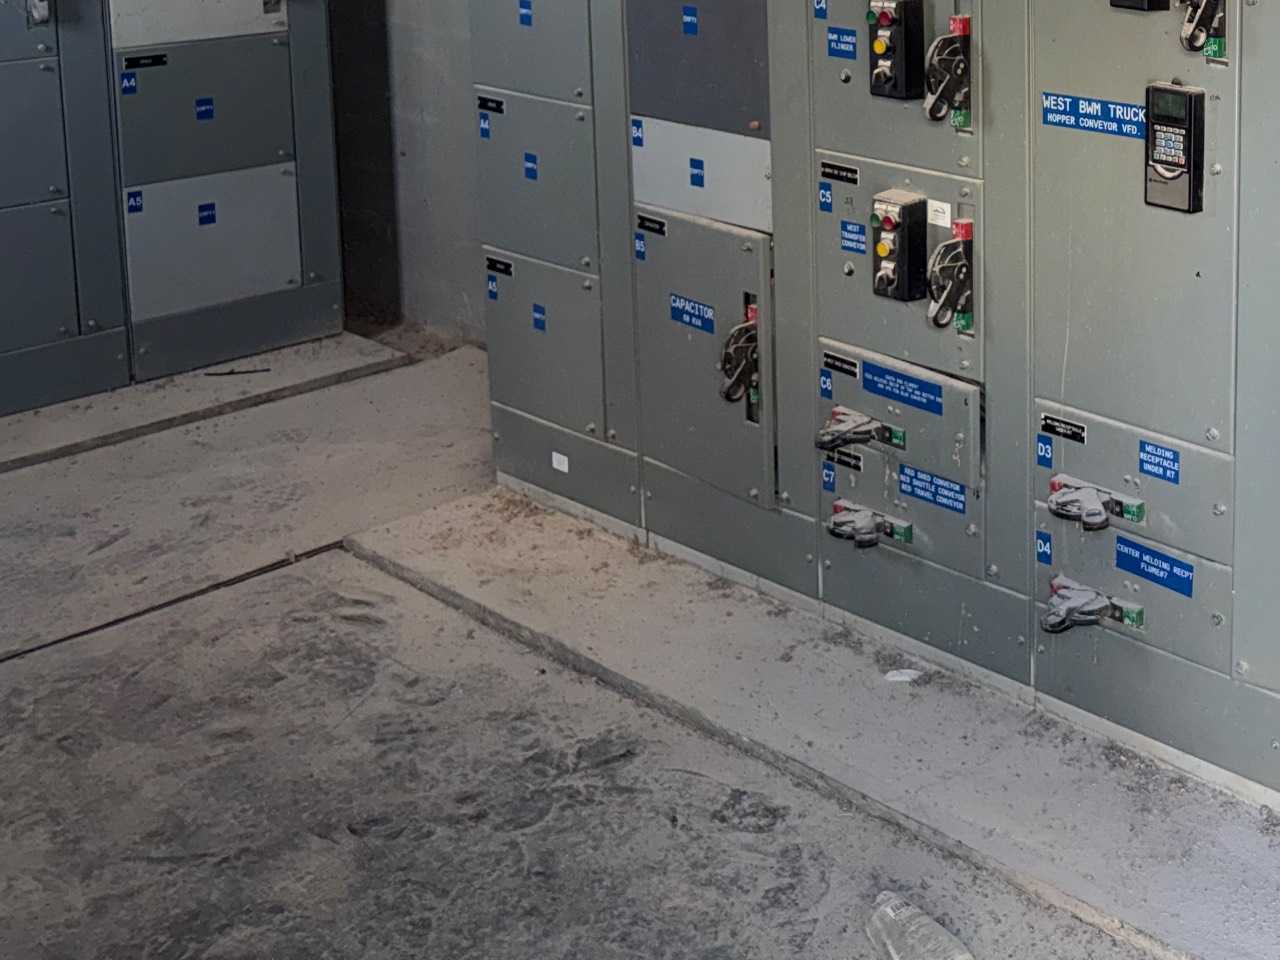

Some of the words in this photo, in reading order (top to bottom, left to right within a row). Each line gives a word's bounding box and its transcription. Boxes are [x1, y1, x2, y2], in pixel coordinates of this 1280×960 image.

[122, 77, 136, 87] A4
[1043, 95, 1071, 111] WEST
[1079, 99, 1101, 115] BWM
[1108, 104, 1147, 123] TRUCK
[1047, 112, 1075, 126] HOPPER
[1079, 117, 1117, 132] CONVEYOR
[1122, 124, 1141, 136] VFD.
[632, 127, 642, 138] B4
[128, 196, 141, 206] A5
[819, 189, 832, 203] C5
[671, 295, 714, 320] CAPACITOR
[820, 376, 832, 390] C6
[1038, 442, 1052, 458] D3
[1145, 444, 1173, 459] WELDING
[1140, 453, 1179, 470] RECEPTACLE
[823, 470, 834, 481] C7
[1143, 464, 1164, 475] UNDER
[1166, 470, 1176, 478] RT
[1037, 541, 1051, 554] D4
[1117, 543, 1140, 558] CENTER
[1143, 553, 1170, 571] WELDING
[1173, 565, 1194, 580] RECPT
